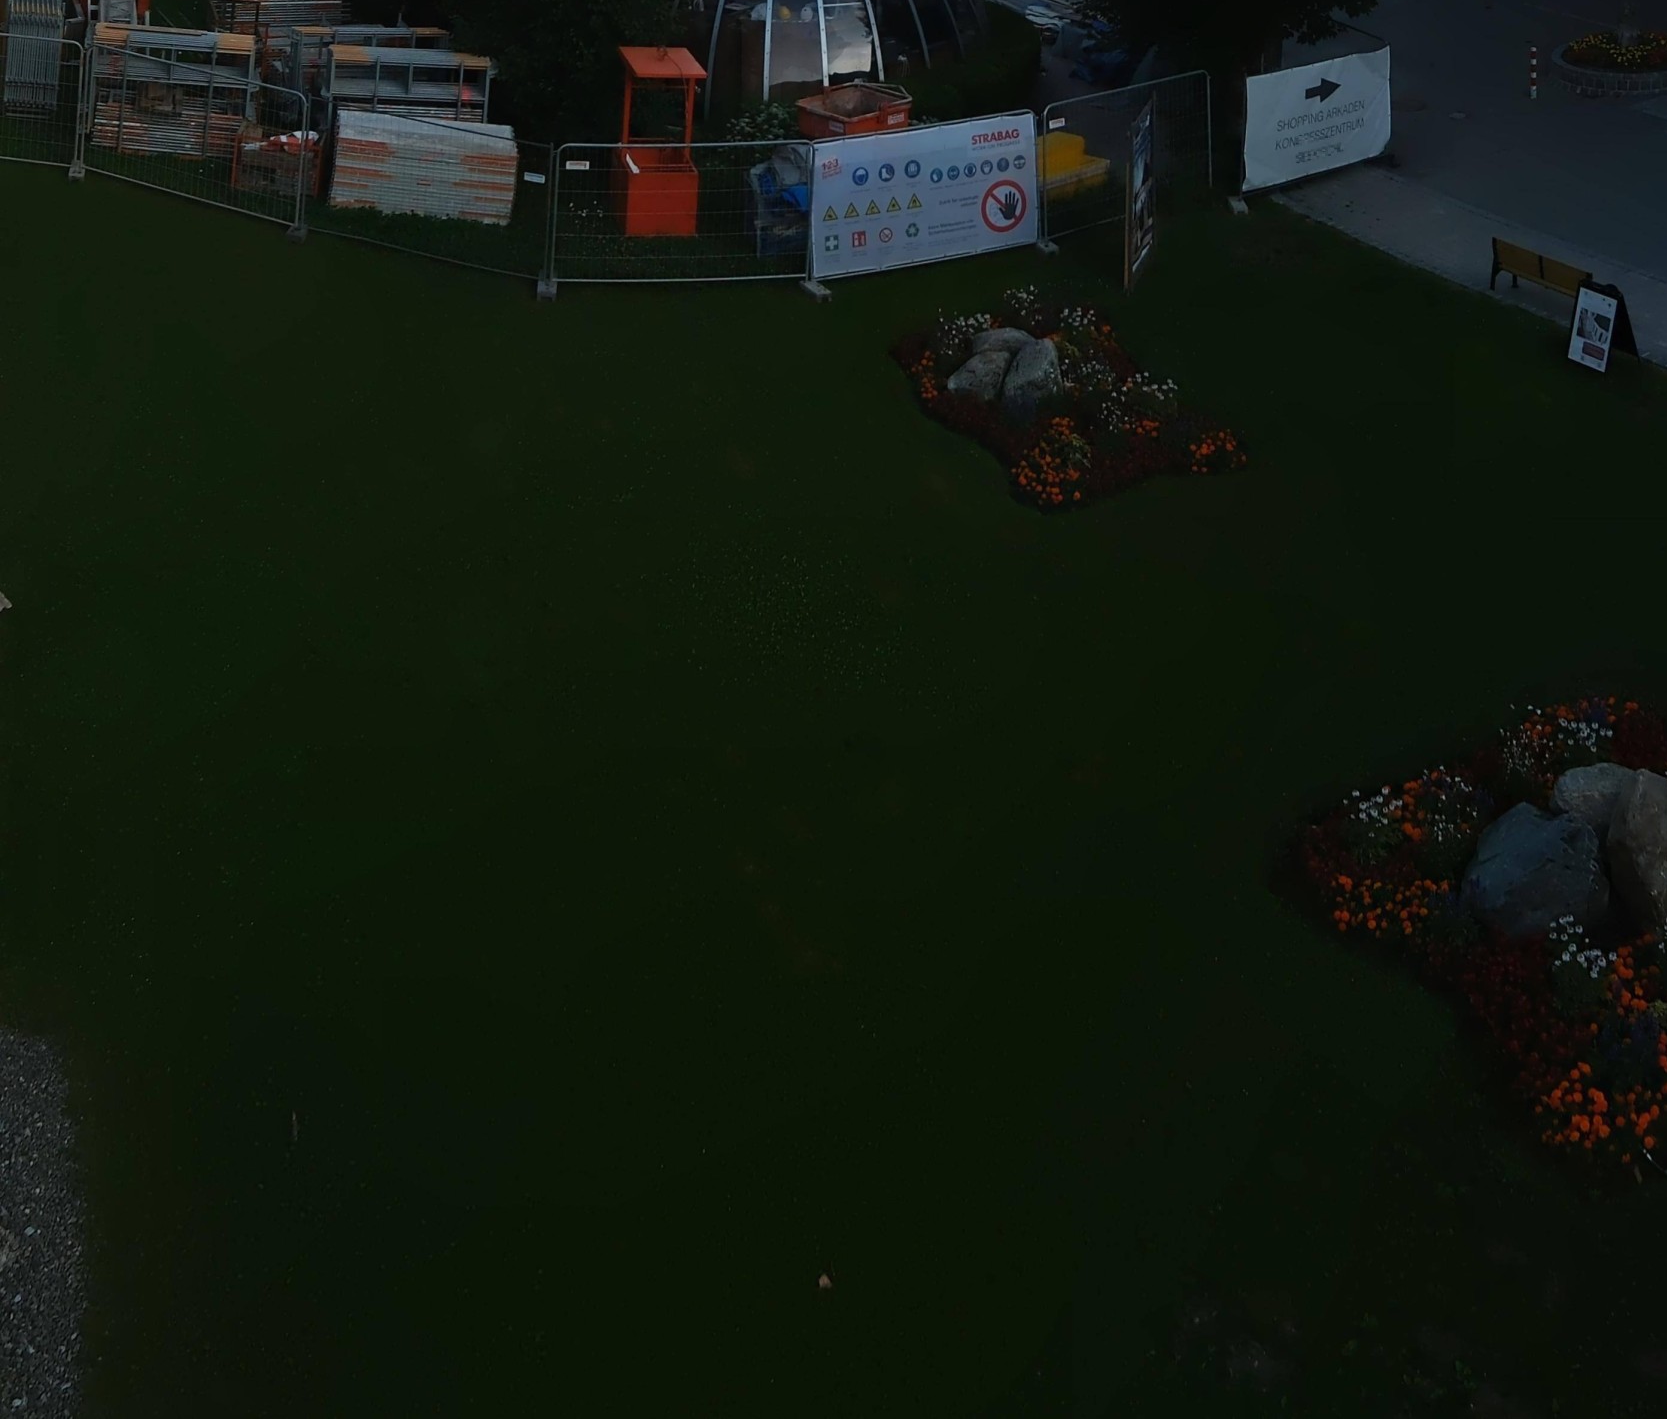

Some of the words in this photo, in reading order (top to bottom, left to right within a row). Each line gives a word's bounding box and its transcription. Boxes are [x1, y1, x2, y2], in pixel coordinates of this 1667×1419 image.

[1276, 111, 1324, 132] SHOPPING
[1325, 100, 1365, 120] ARKADEN
[971, 129, 1020, 145] STRABAG
